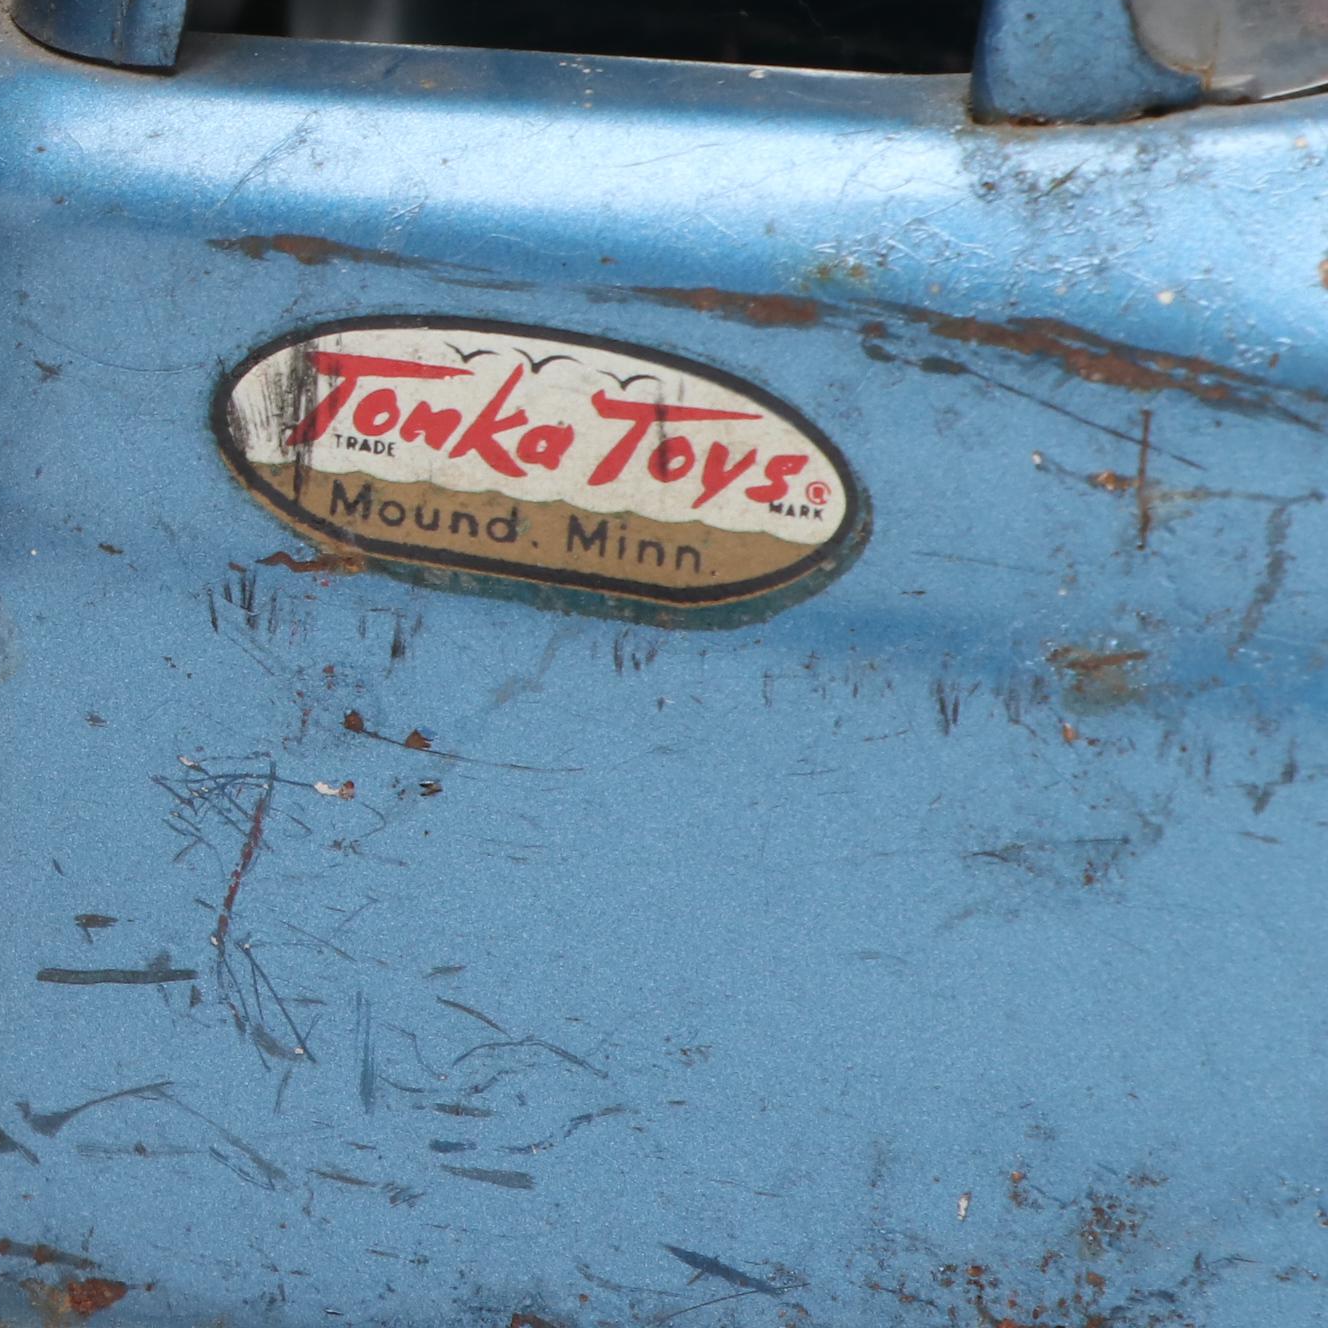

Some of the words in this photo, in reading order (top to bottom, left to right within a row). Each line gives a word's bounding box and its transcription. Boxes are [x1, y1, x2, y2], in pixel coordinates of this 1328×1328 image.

[287, 352, 575, 477] Tonka
[334, 433, 396, 457] TRADE
[768, 502, 823, 522] MARK
